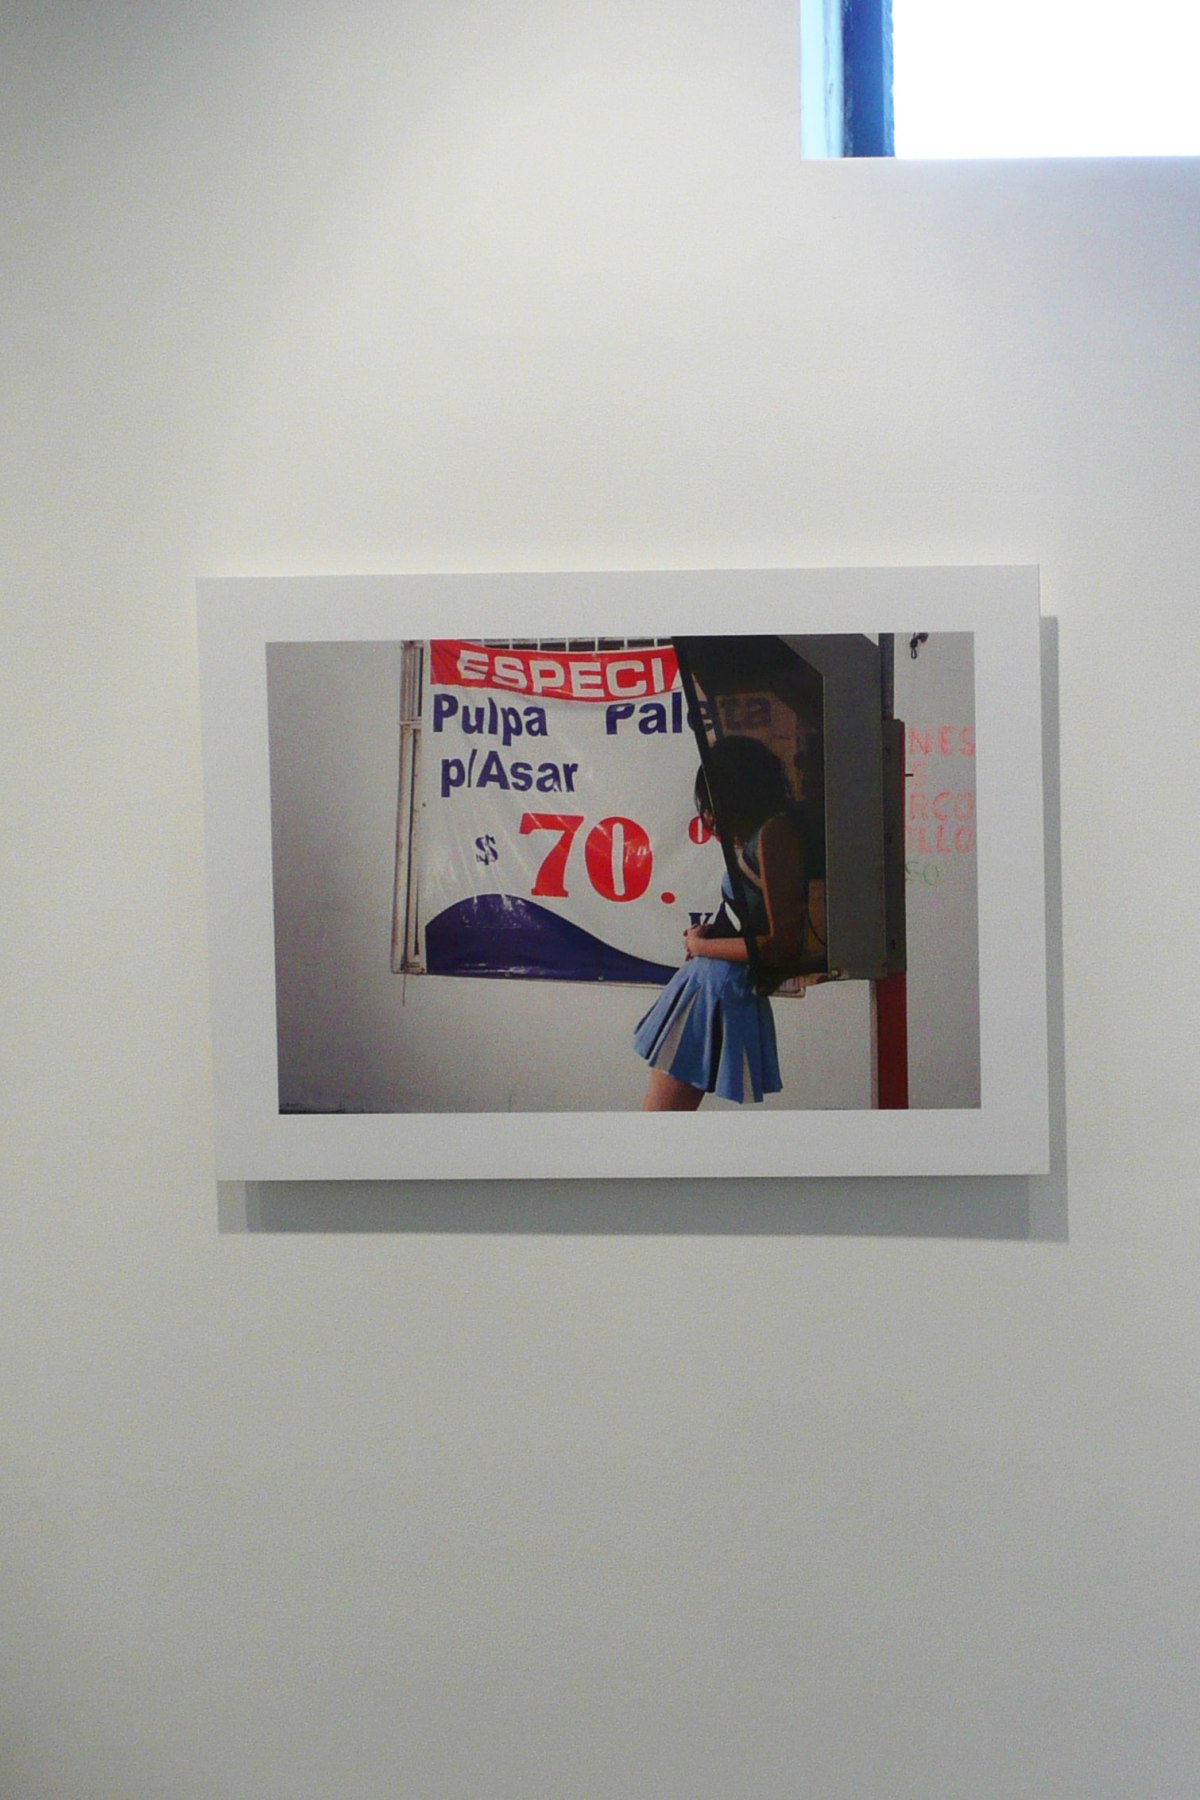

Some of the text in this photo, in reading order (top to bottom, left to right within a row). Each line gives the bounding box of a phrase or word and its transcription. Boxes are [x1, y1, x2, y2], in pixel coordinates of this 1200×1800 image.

[457, 649, 684, 698] ESPECI
[433, 693, 548, 746] Pulpa
[441, 748, 578, 798] p/Asar
[475, 834, 499, 866] $
